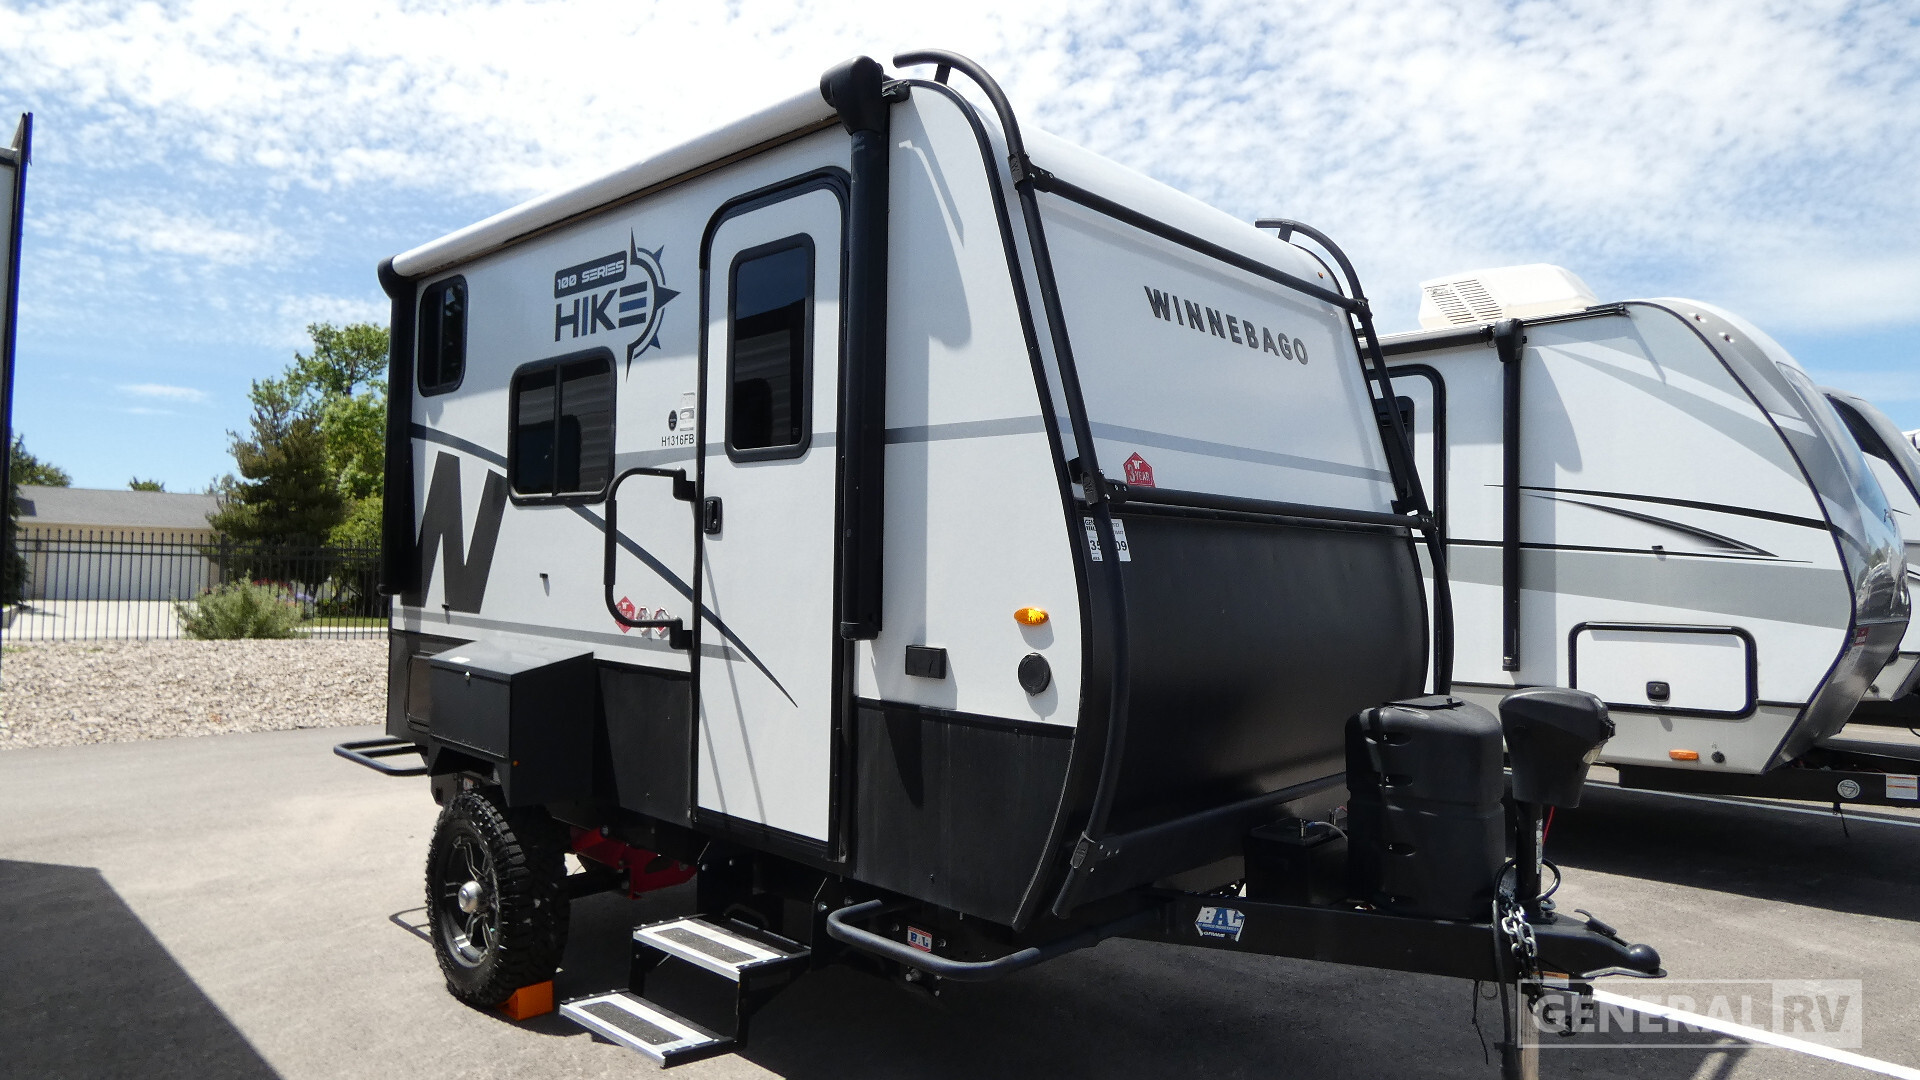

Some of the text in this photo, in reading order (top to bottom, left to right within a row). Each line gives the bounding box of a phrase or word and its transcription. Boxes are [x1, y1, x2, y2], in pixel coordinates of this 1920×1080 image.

[557, 259, 625, 290] 100 SERIES
[554, 280, 648, 342] HIKE
[1143, 285, 1309, 365] WINNEBAGO
[661, 433, 695, 447] H1316FB
